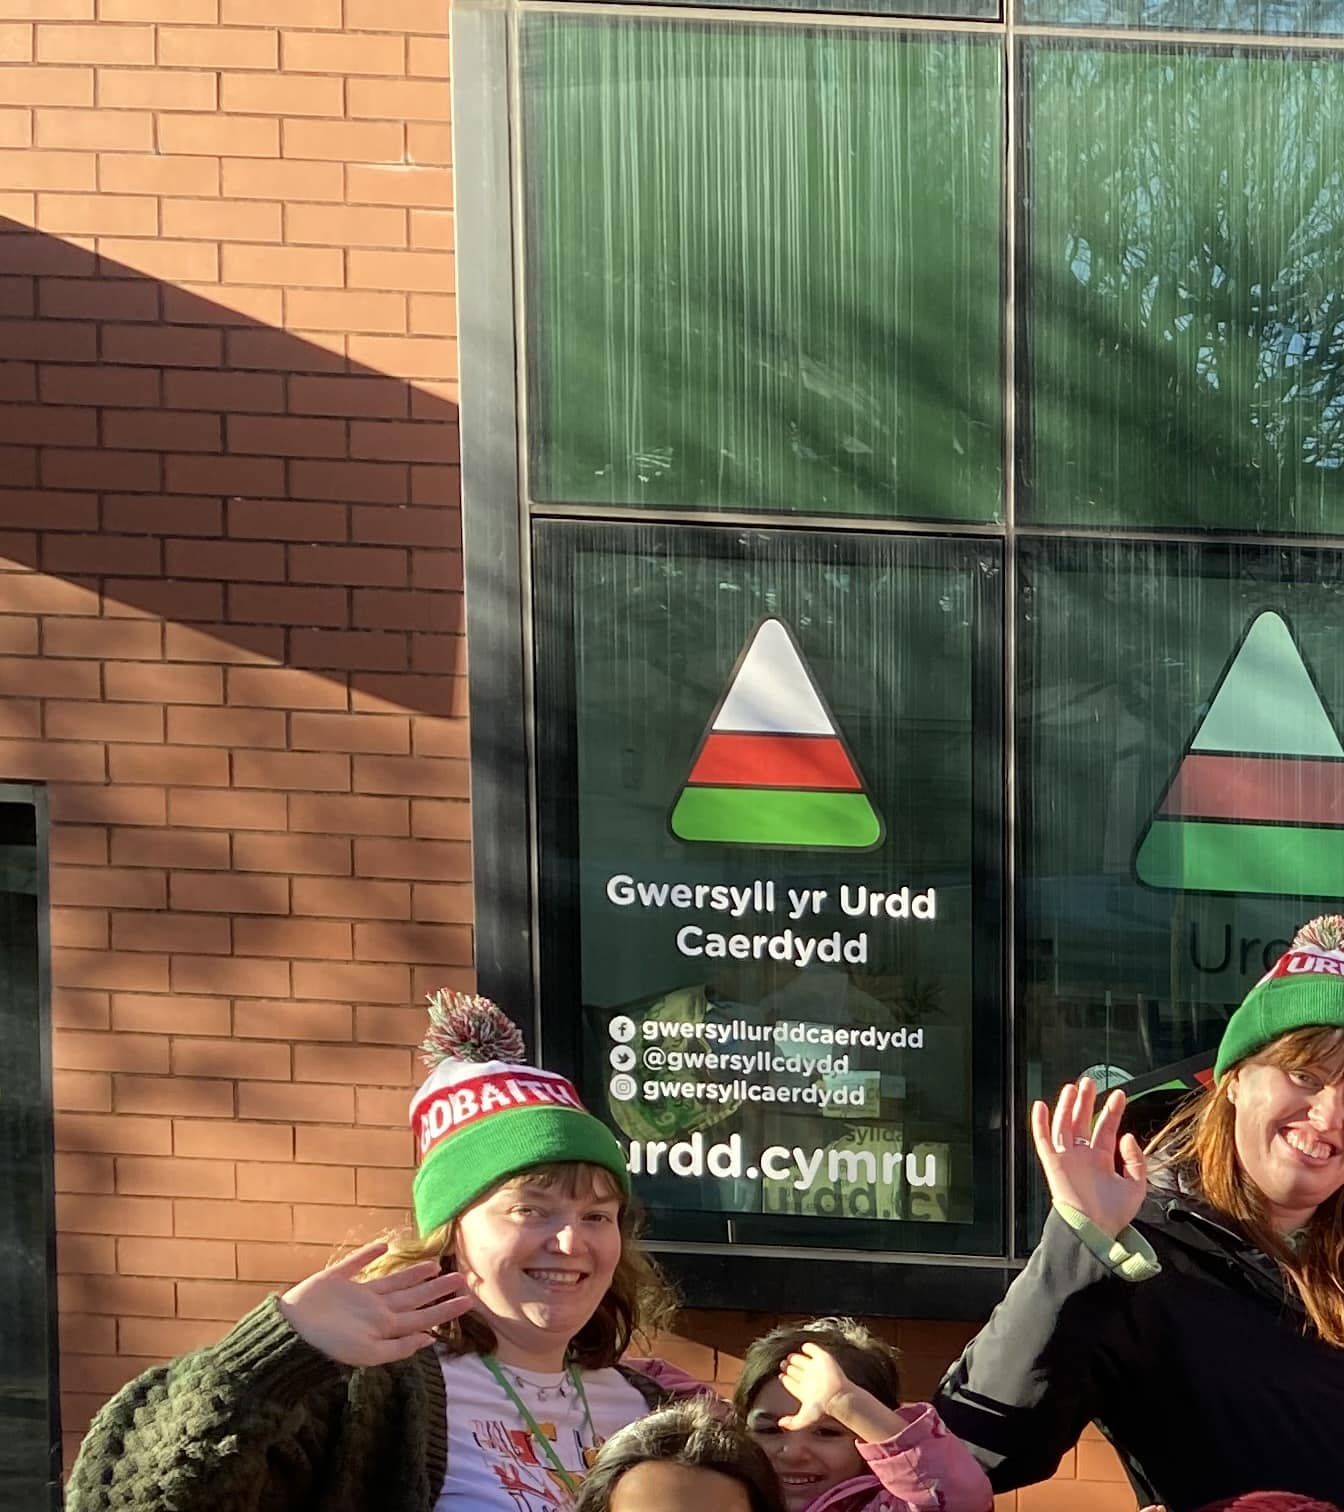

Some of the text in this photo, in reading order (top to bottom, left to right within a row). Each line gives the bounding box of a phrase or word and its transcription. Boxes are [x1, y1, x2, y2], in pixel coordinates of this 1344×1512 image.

[606, 874, 936, 920] Gwersyll yr Urdd
[676, 925, 868, 967] Caerdydd
[642, 1019, 924, 1050] gwersyllurddcaerdydd
[643, 1046, 850, 1077] @gwersyllcdydd
[643, 1079, 866, 1107] gwersyllcaerdydd
[615, 1131, 936, 1191] urdd.cymru
